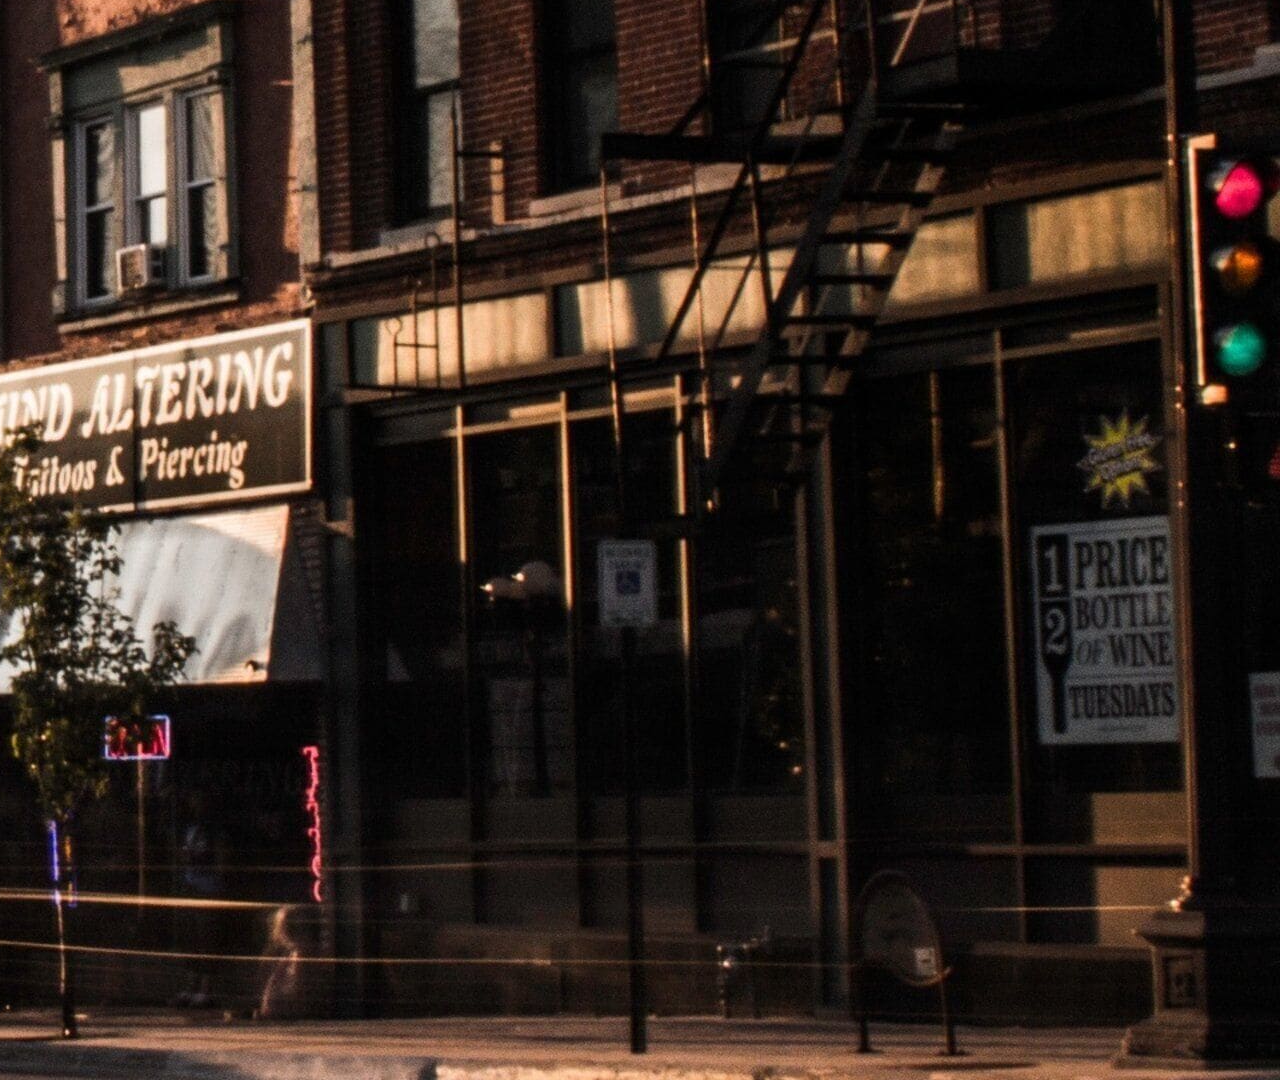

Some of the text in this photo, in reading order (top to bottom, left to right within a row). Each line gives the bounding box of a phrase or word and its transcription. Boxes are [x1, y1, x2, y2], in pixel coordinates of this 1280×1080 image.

[81, 341, 294, 439] ALTERING
[105, 445, 125, 487] &
[141, 429, 248, 489] Piercing
[1044, 542, 1064, 593] 1
[1074, 536, 1169, 590] PRICE
[1044, 608, 1067, 655] 2
[1075, 592, 1170, 630] BOTTLE
[1075, 631, 1173, 667] OF WINE
[1068, 681, 1176, 719] TUESDAYS
